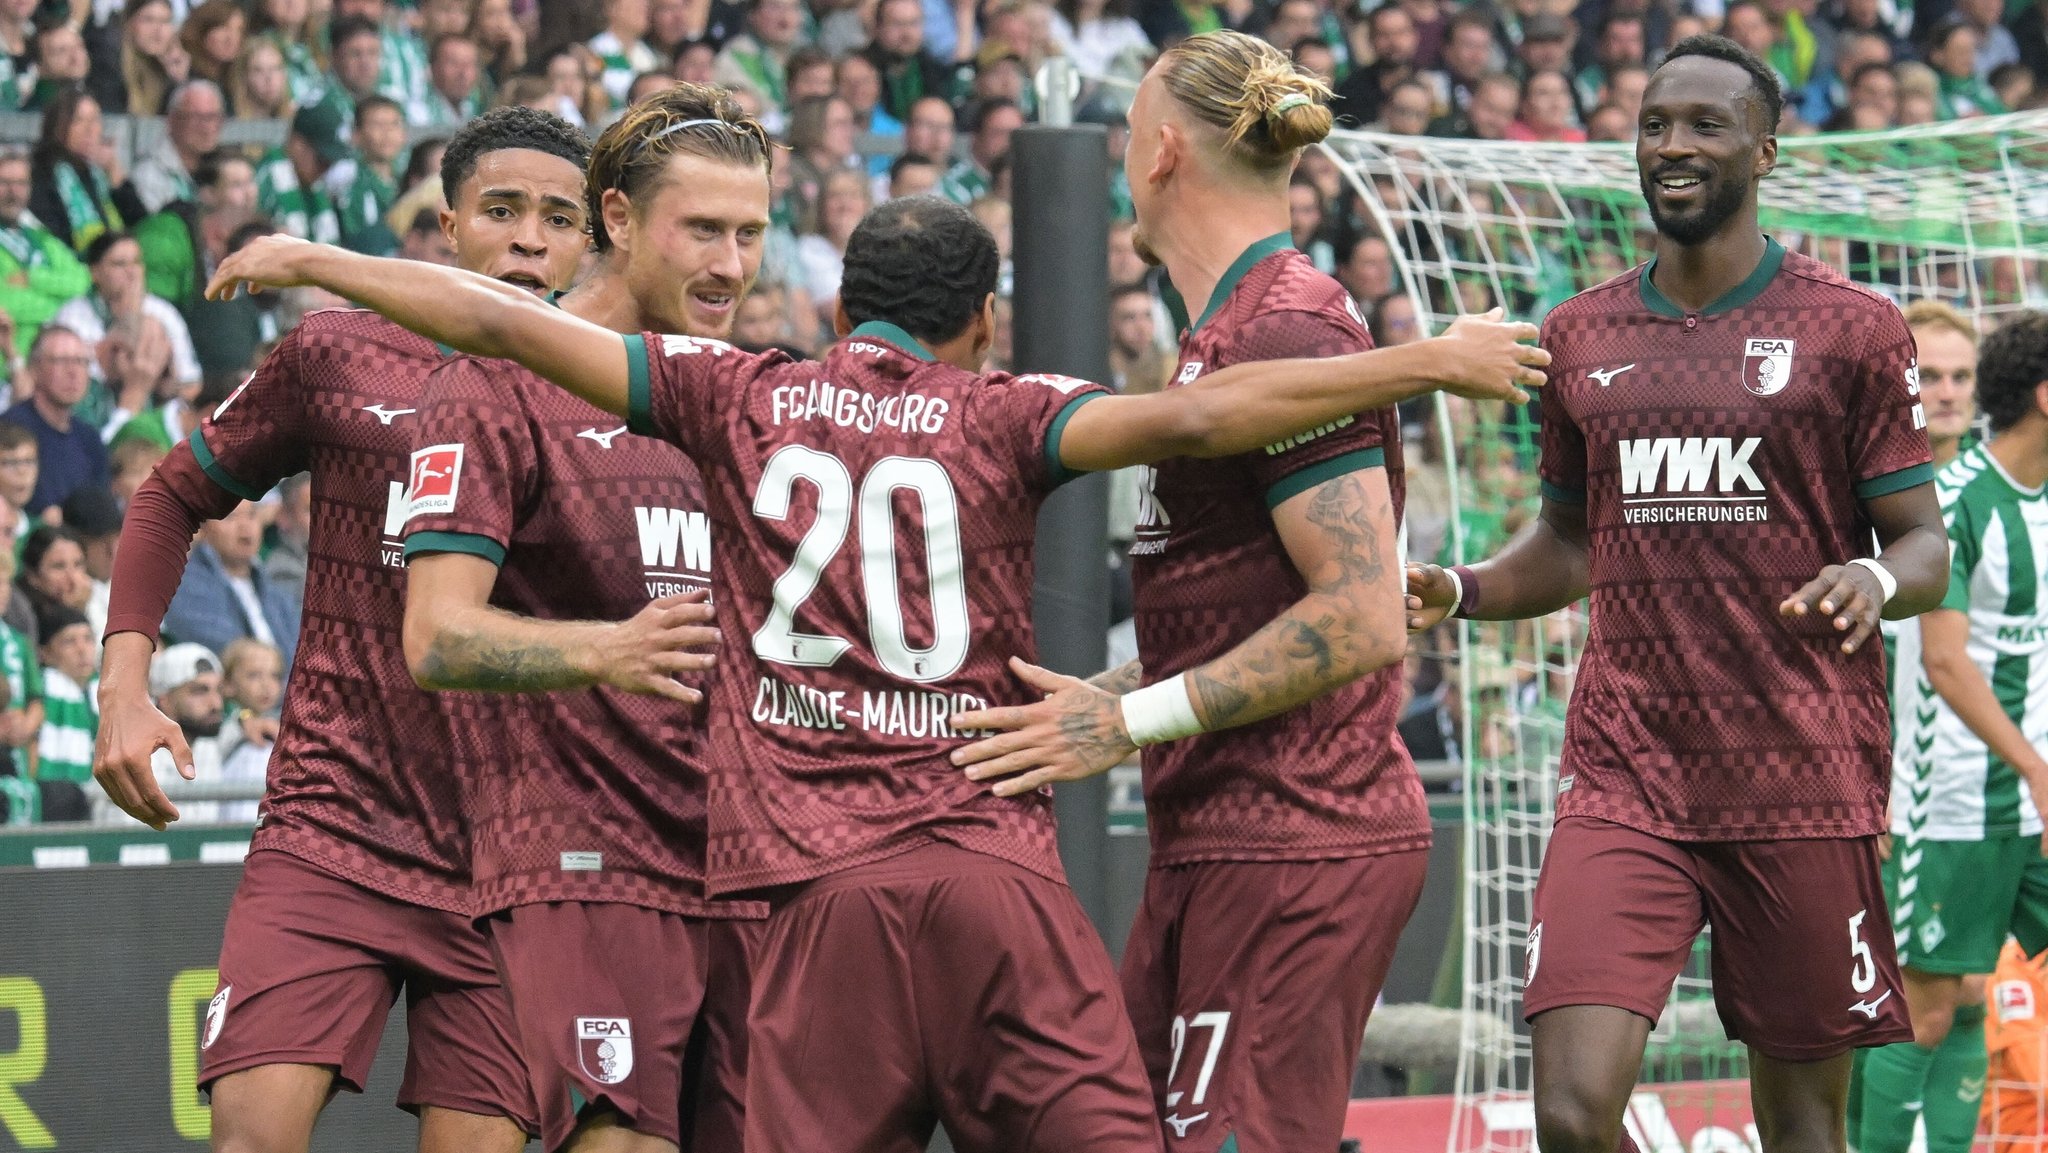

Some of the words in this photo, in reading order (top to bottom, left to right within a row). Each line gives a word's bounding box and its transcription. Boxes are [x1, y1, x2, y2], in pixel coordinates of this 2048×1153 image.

[848, 342, 888, 358] 1907
[1751, 341, 1788, 353] FCA
[1618, 437, 1766, 494] WWK
[1623, 506, 1768, 524] VERSICHERUNGEN
[752, 444, 970, 683] 20
[1848, 909, 1876, 994] 5
[583, 1021, 625, 1035] FCA
[1166, 1011, 1232, 1106] 27
